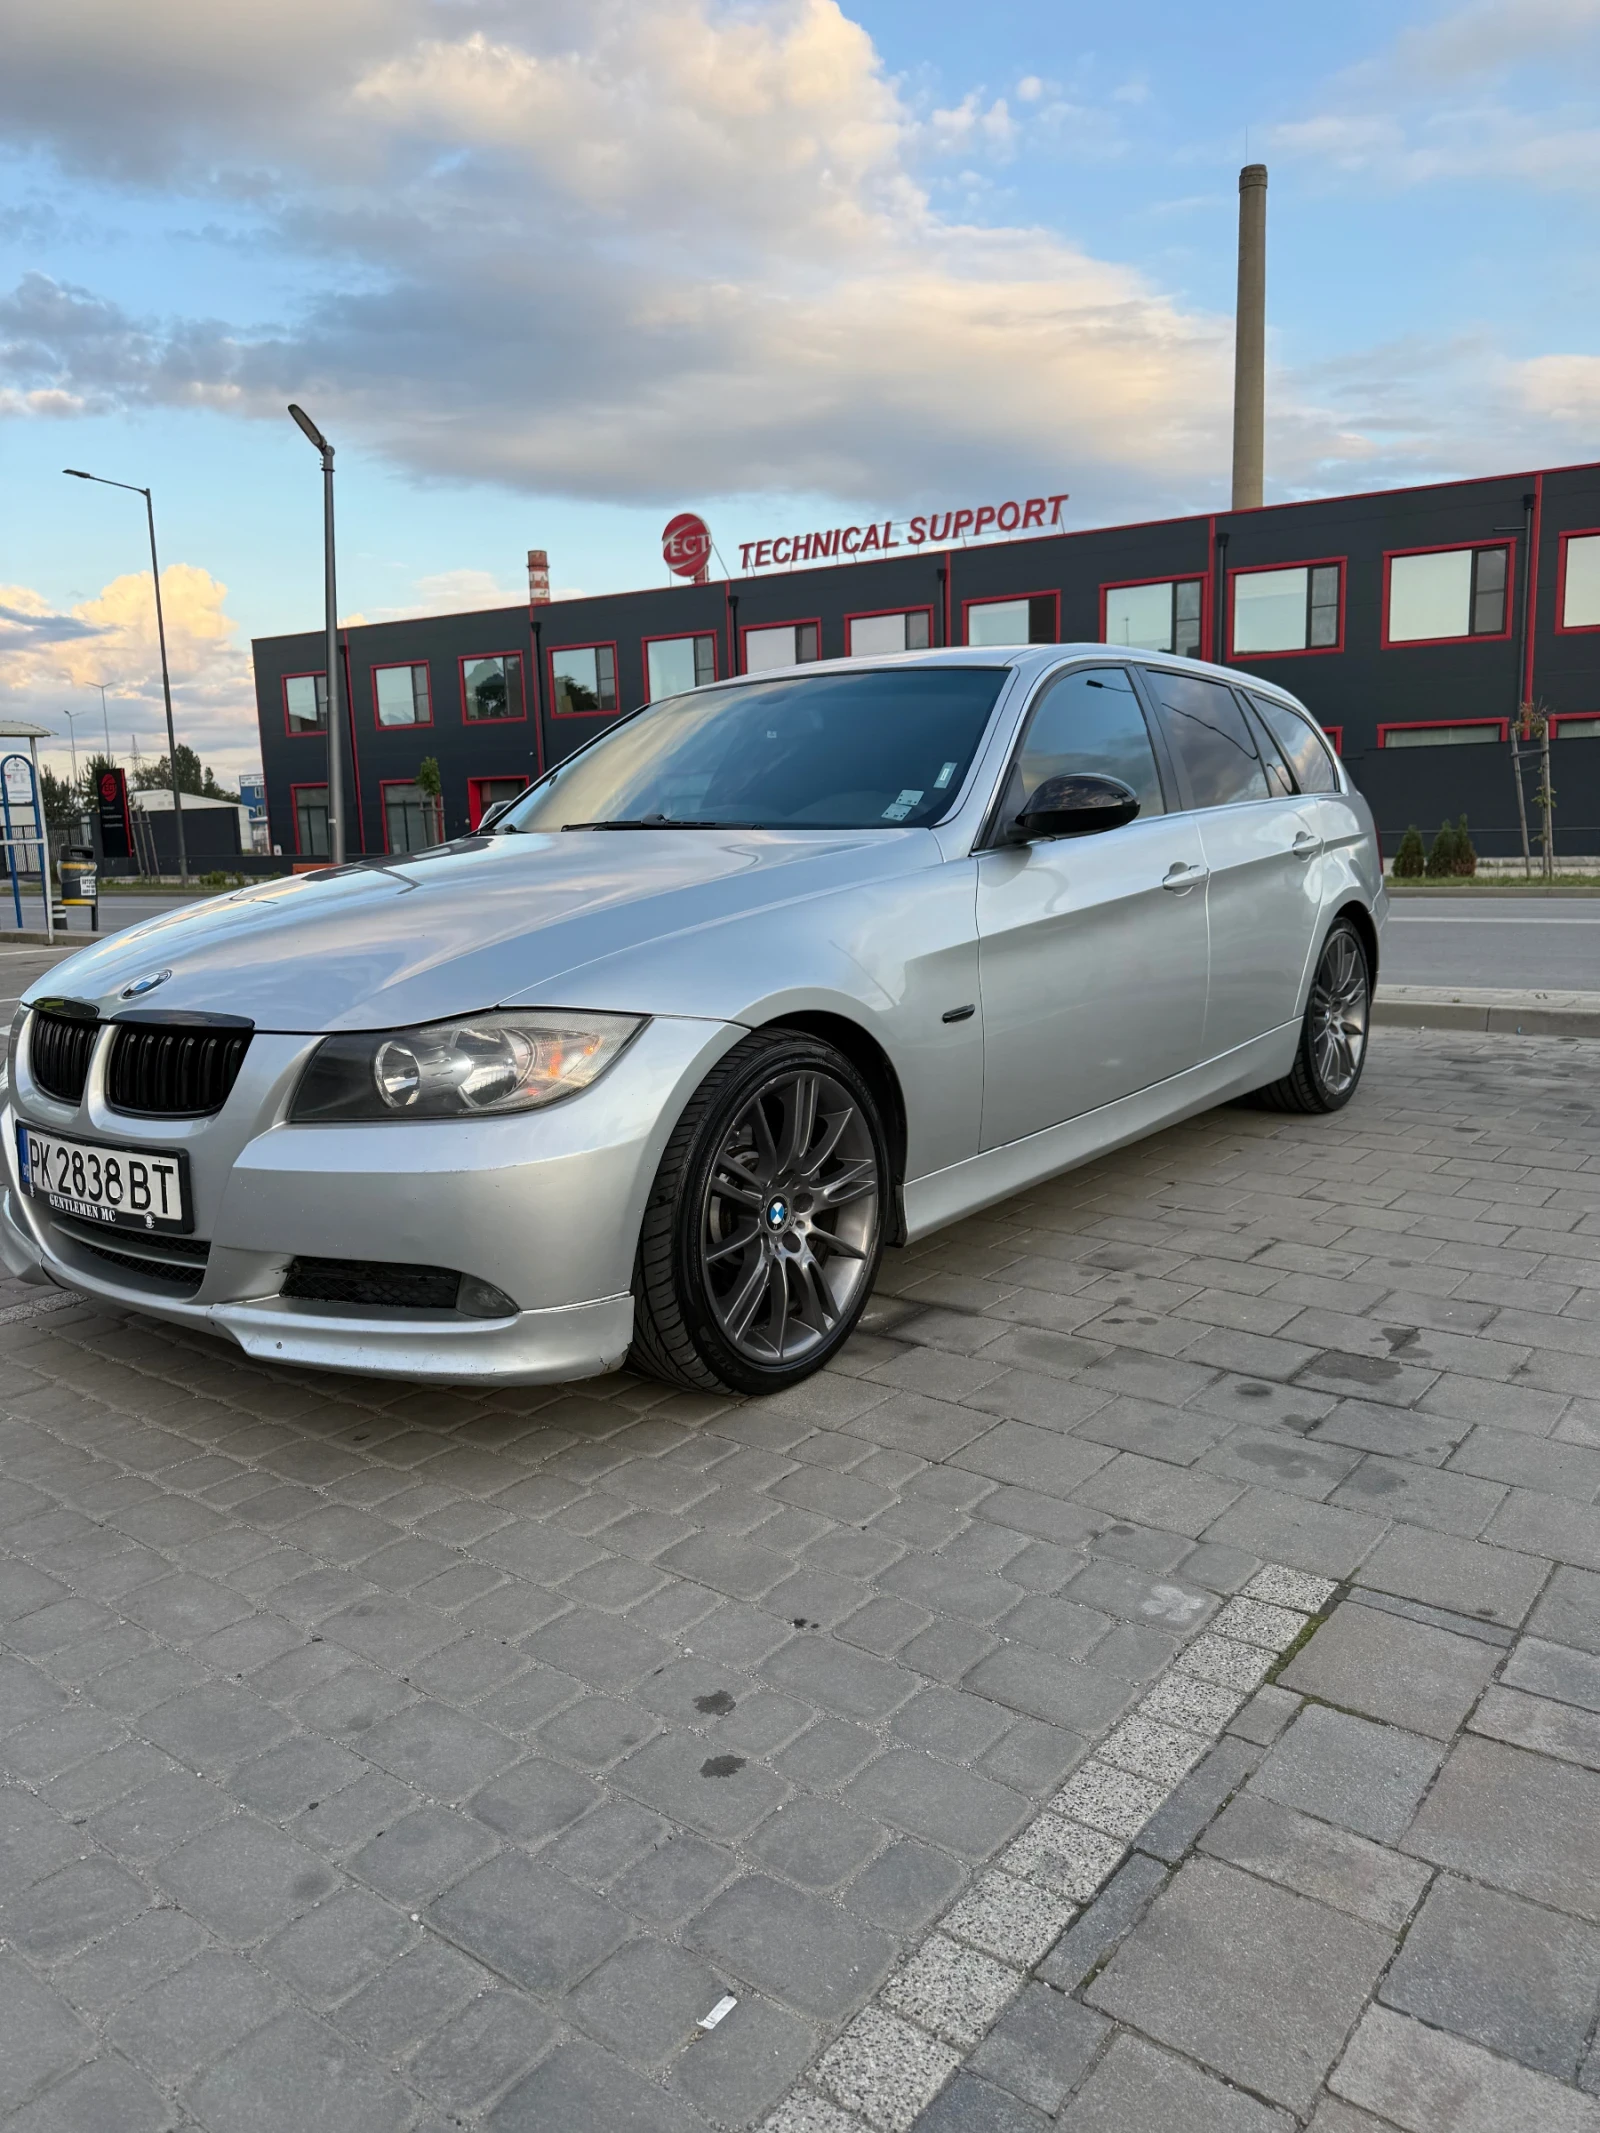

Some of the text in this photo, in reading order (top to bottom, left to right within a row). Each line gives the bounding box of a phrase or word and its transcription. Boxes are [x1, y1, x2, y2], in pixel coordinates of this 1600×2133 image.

[669, 533, 711, 557] EGT
[738, 494, 1070, 569] TECHNICAL SUPPORT
[29, 1138, 174, 1214] PK 2838 BT
[49, 1193, 117, 1223] GENTLEMEN MC
